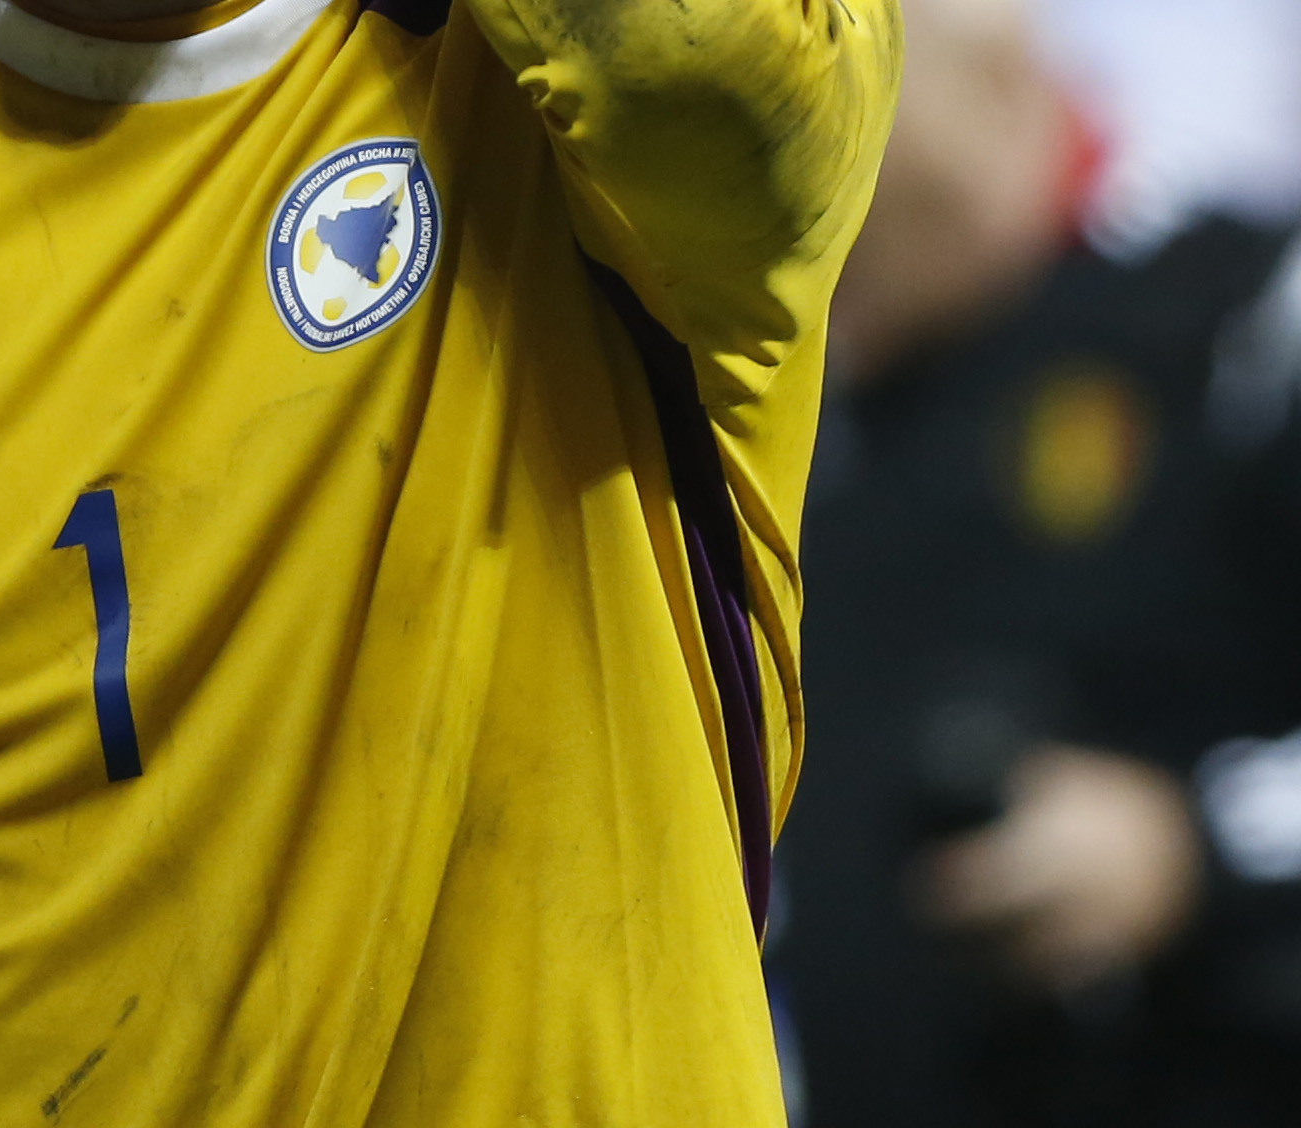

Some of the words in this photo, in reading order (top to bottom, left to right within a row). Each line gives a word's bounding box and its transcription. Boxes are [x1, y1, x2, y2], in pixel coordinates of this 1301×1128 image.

[278, 208, 299, 244] BOSNA
[296, 153, 357, 204] HERCEGOVINA
[358, 147, 391, 162] БОСНА
[52, 488, 143, 783] 1
